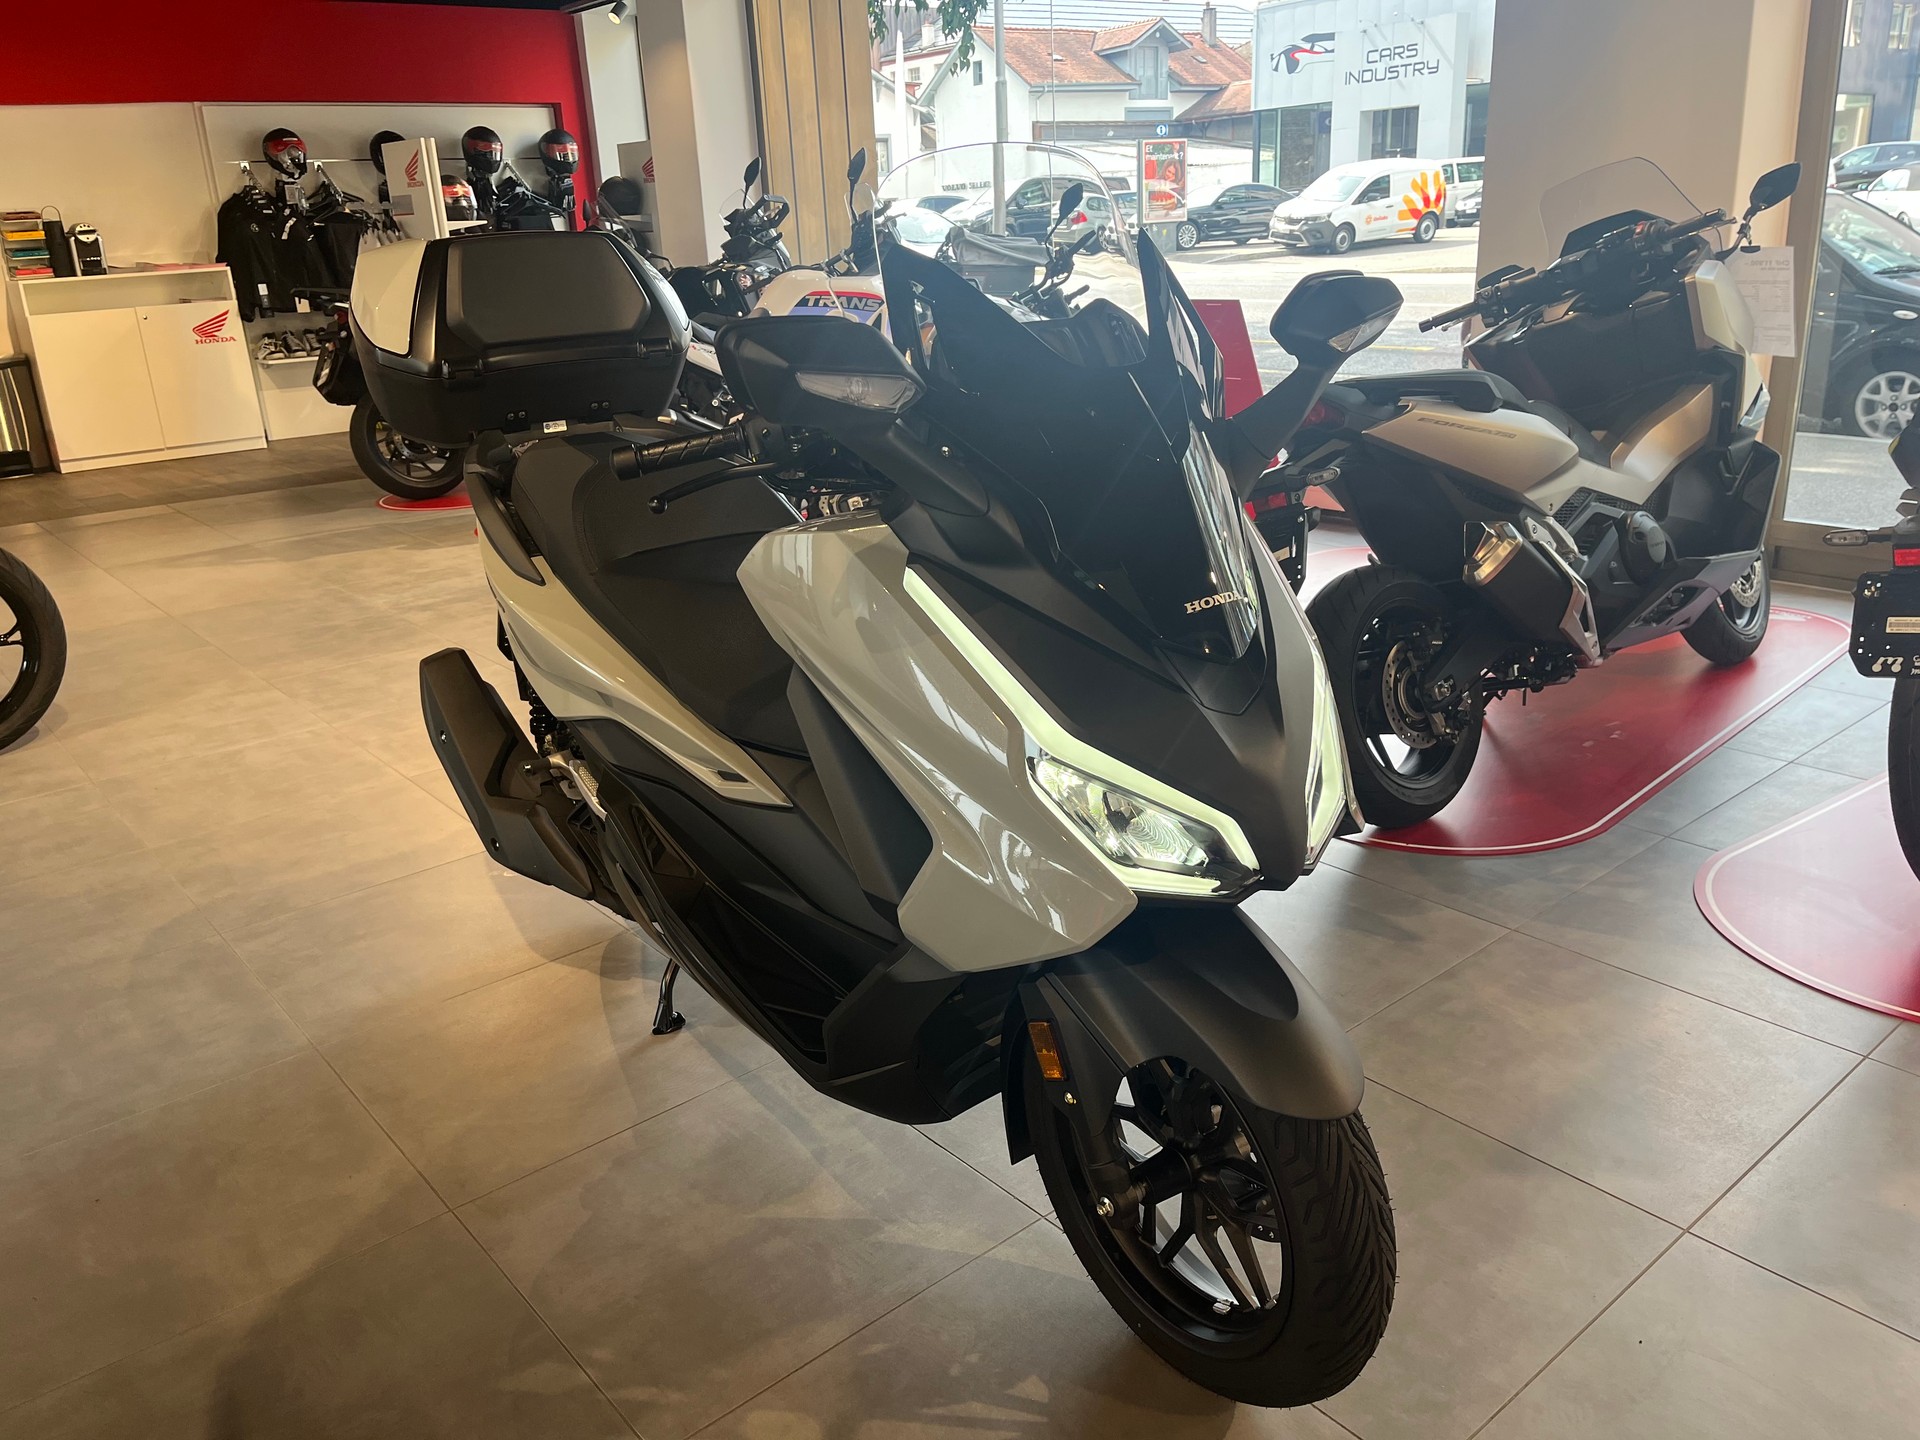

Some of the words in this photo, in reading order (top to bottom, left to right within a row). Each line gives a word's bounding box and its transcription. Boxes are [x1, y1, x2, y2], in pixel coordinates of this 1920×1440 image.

[1367, 43, 1418, 64] CARS
[1345, 58, 1440, 86] INDUSTRY
[941, 183, 967, 192] VOLVO
[805, 296, 881, 311] TRANS
[195, 336, 237, 344] HONDA
[1184, 590, 1243, 614] HONDA
